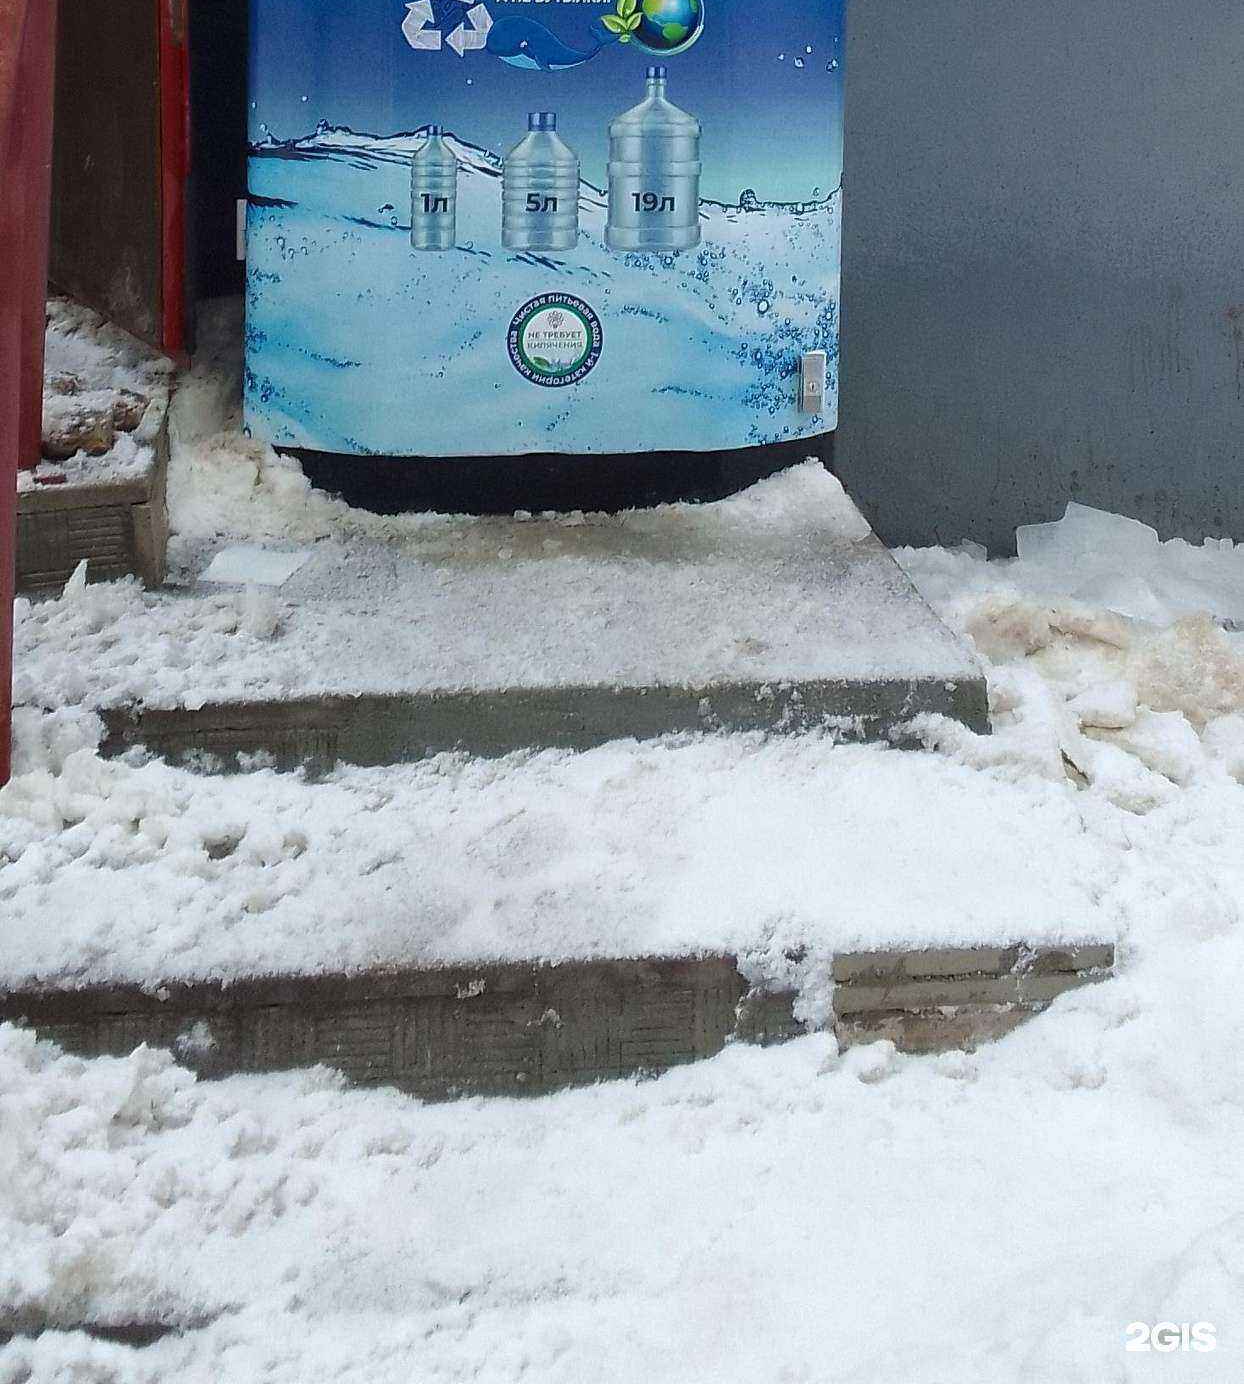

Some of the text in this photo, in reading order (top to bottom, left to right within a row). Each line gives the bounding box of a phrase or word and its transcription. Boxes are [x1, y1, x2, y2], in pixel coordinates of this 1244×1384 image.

[421, 192, 448, 213] 1л
[525, 192, 558, 213] 5л
[631, 192, 675, 213] 19л
[527, 340, 583, 349] КИПЯЧЕНИЯ
[528, 331, 582, 339] НЕ ТРЕБУЕТ
